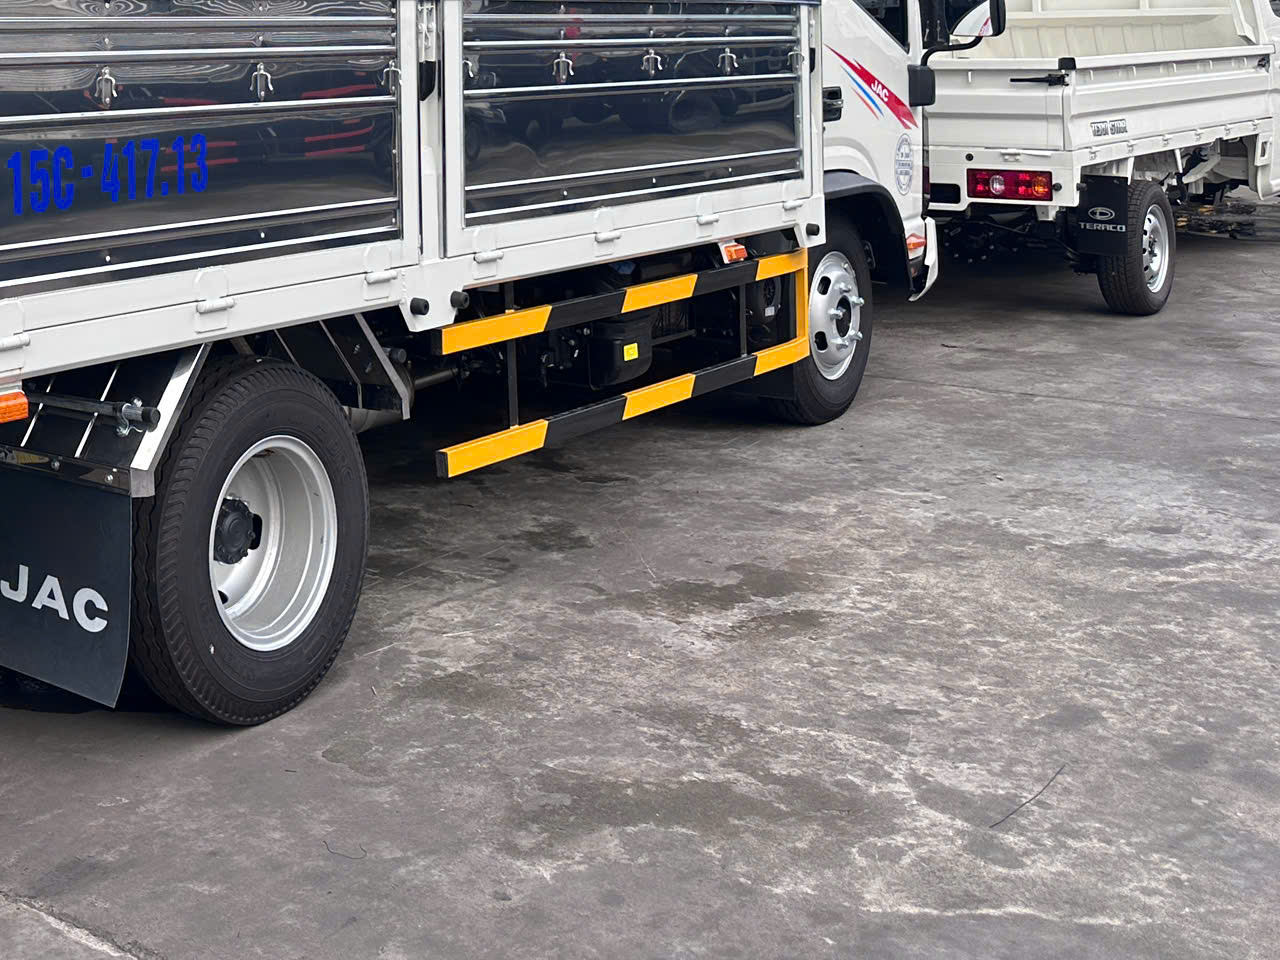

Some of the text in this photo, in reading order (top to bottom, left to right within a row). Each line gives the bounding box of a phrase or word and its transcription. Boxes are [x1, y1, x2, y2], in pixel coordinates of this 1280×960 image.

[870, 80, 889, 102] JAC
[7, 133, 209, 216] 15C-417.13
[1079, 222, 1126, 232] TERACO
[0, 564, 108, 633] JAC
